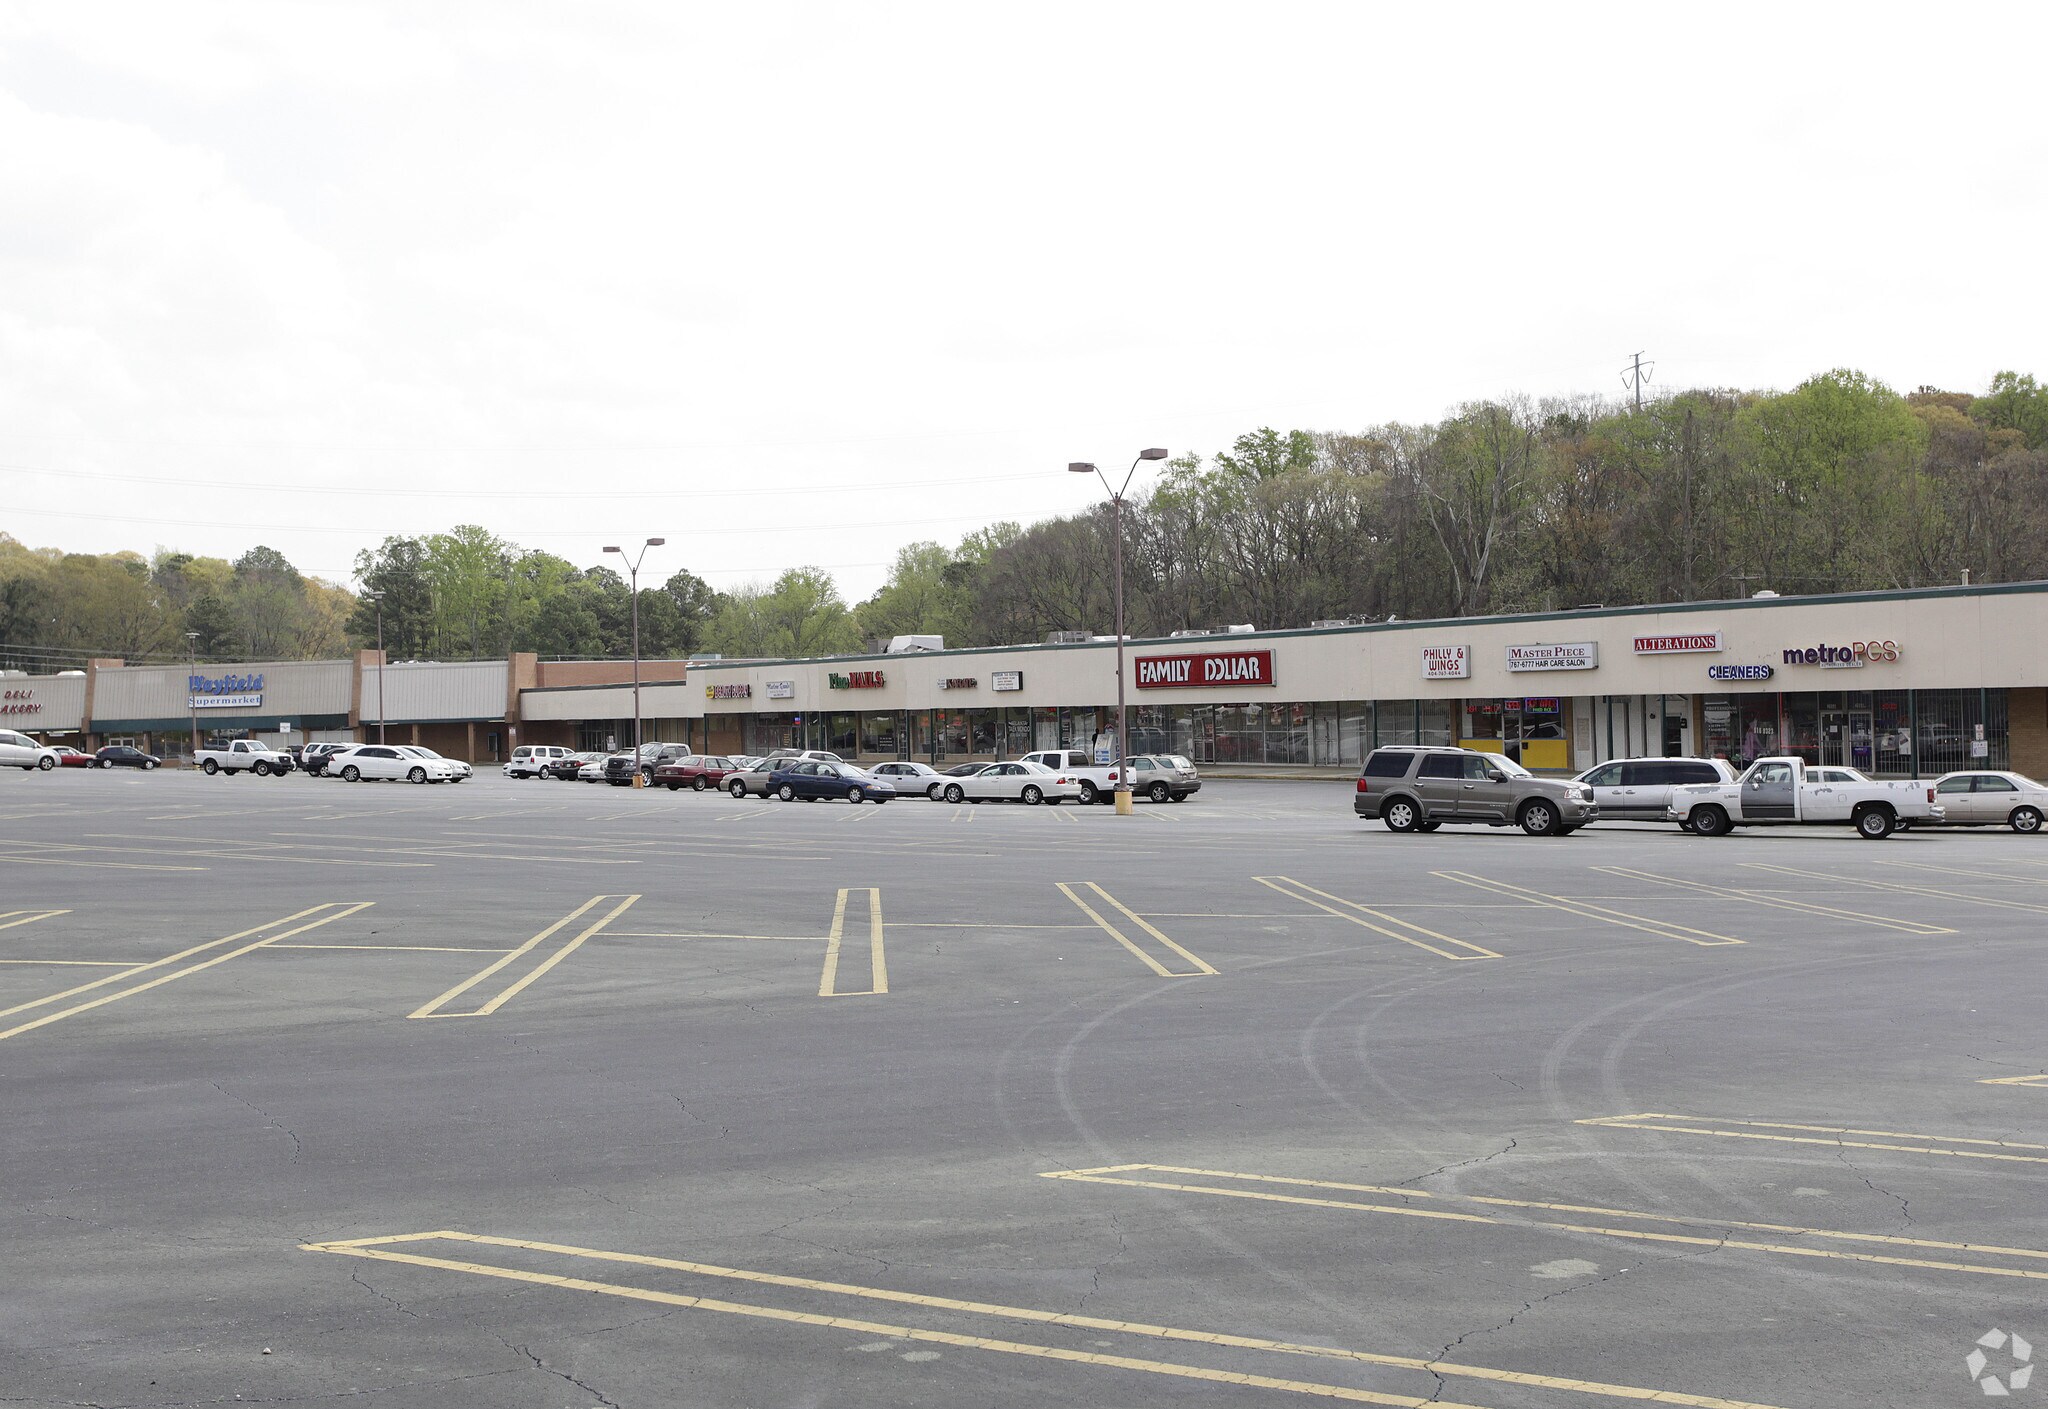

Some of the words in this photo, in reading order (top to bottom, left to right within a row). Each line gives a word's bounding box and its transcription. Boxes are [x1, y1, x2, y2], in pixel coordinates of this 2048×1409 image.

[1635, 637, 1715, 650] ALTERATIONS
[1423, 648, 1451, 660] PHILLY
[1456, 647, 1464, 659] &
[1511, 648, 1552, 658] MASTER
[1554, 646, 1585, 657] PIECE
[1783, 641, 1897, 664] metroPCS
[1140, 660, 1192, 683] FAMILY
[1204, 657, 1260, 681] DOLLAR
[1428, 659, 1459, 671] WINGS
[1511, 660, 1535, 669] 767-6777
[1535, 660, 1549, 668] HAIR
[1549, 659, 1566, 667] CARE
[1566, 658, 1586, 667] SALON
[1708, 664, 1770, 680] CLEANERS
[188, 674, 264, 695] Wayfield
[849, 670, 884, 689] NAILS
[4, 689, 33, 699] DELI
[188, 696, 261, 706] Supermarket
[0, 704, 41, 713] AKERY
